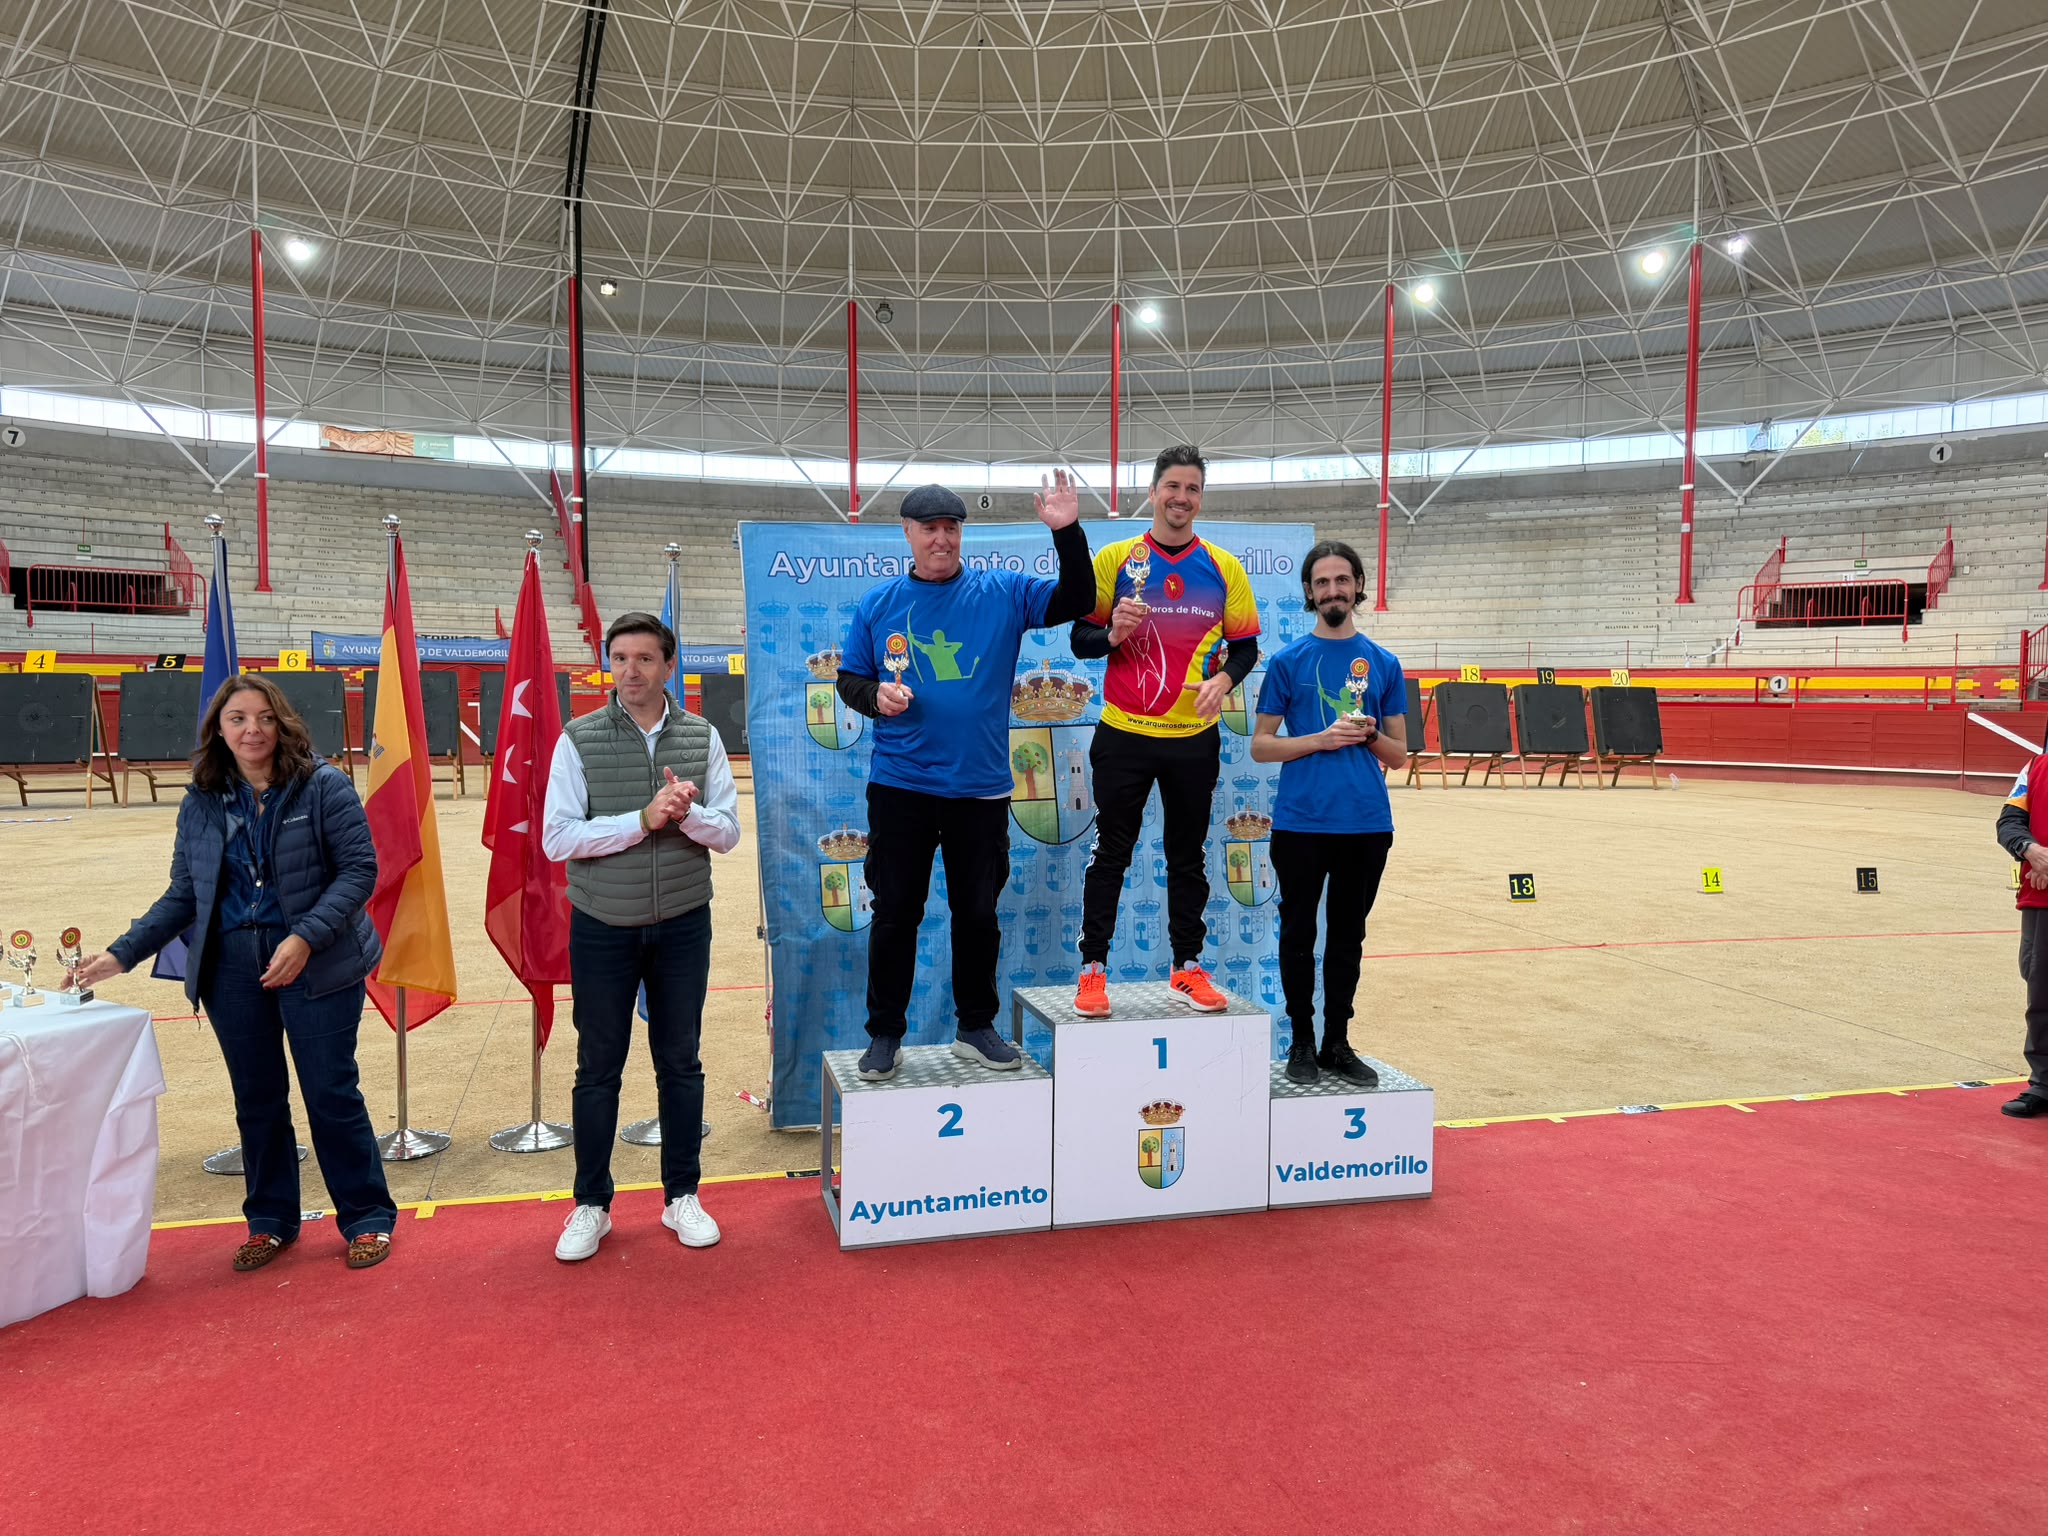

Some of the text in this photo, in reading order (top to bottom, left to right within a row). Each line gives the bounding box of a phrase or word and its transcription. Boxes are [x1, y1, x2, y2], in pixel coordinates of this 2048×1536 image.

[8, 430, 20, 445] 7
[1936, 446, 1945, 461] 1
[981, 495, 990, 509] 8
[1176, 605, 1189, 614] de
[1191, 605, 1215, 618] Rivas
[427, 648, 442, 657] DE
[33, 653, 47, 669] 4
[163, 655, 177, 668] 5
[286, 652, 299, 669] 6
[1463, 667, 1479, 682] 18
[1541, 670, 1555, 685] 19
[1612, 671, 1629, 686] 20
[1774, 678, 1782, 690] 1
[1510, 877, 1534, 897] 13
[1703, 871, 1721, 888] 14
[1859, 872, 1877, 889] 15
[1152, 1037, 1168, 1069] 1
[937, 1103, 964, 1138] 2
[1343, 1107, 1367, 1140] 3
[1275, 1154, 1429, 1184] Valdemorillo
[848, 1186, 1049, 1225] Ayuntamiento
